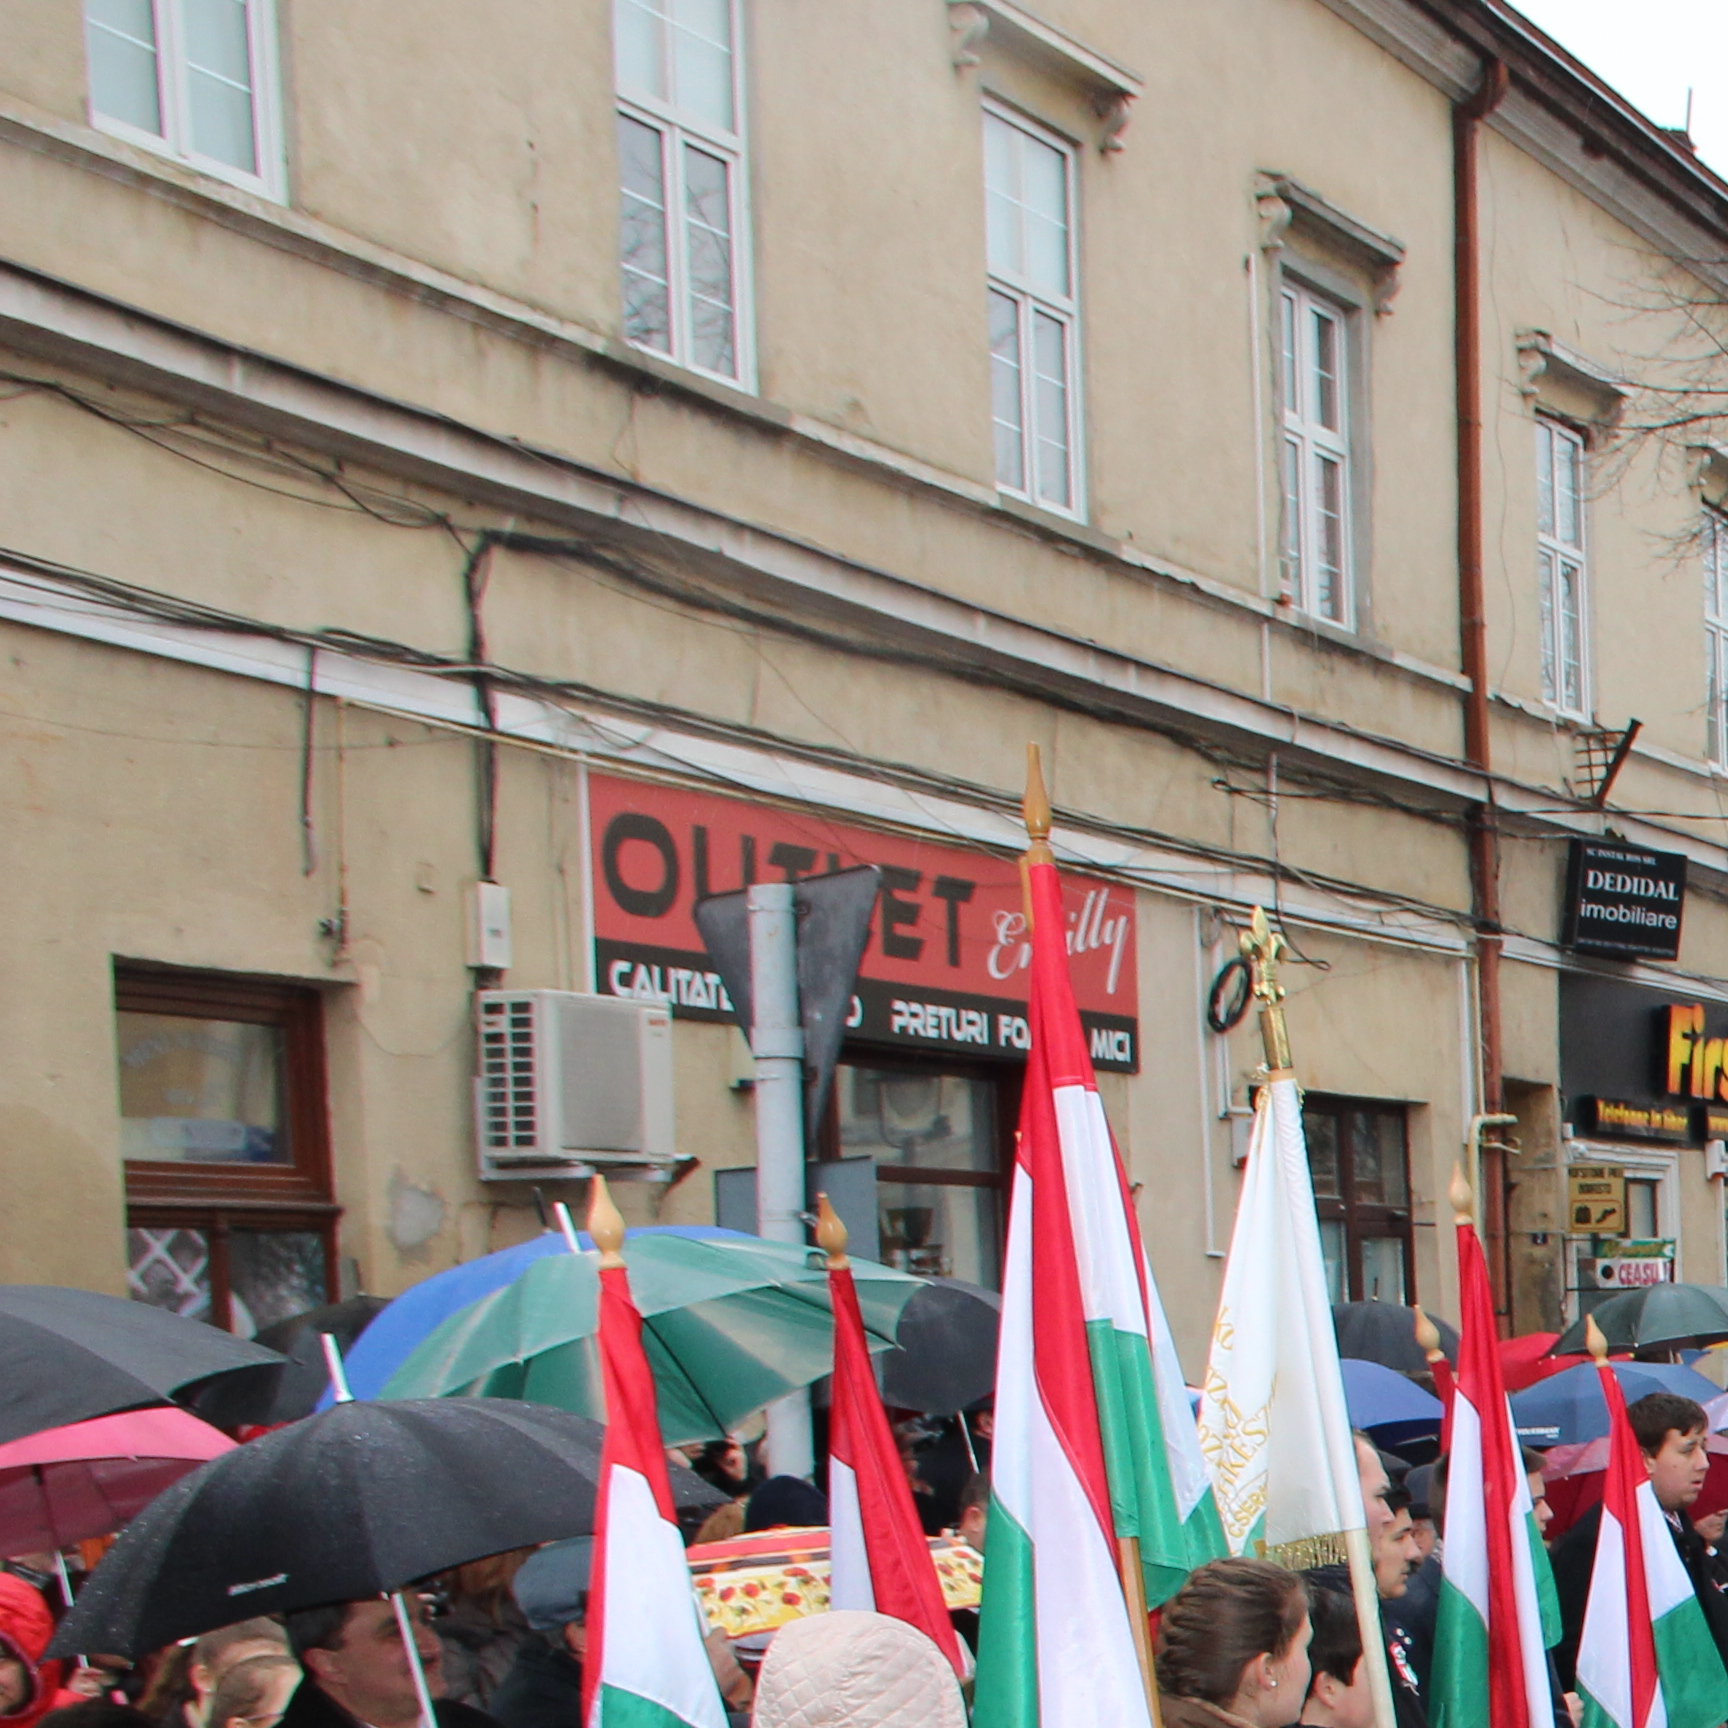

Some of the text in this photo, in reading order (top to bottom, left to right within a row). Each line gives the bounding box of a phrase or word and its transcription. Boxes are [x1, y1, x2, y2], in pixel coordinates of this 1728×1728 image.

[602, 811, 975, 968] OUTET
[1586, 868, 1680, 901] DEDIDAL
[1580, 899, 1678, 930] imobiliare
[890, 999, 990, 1045] PRETURI
[1090, 1027, 1131, 1063] MICI
